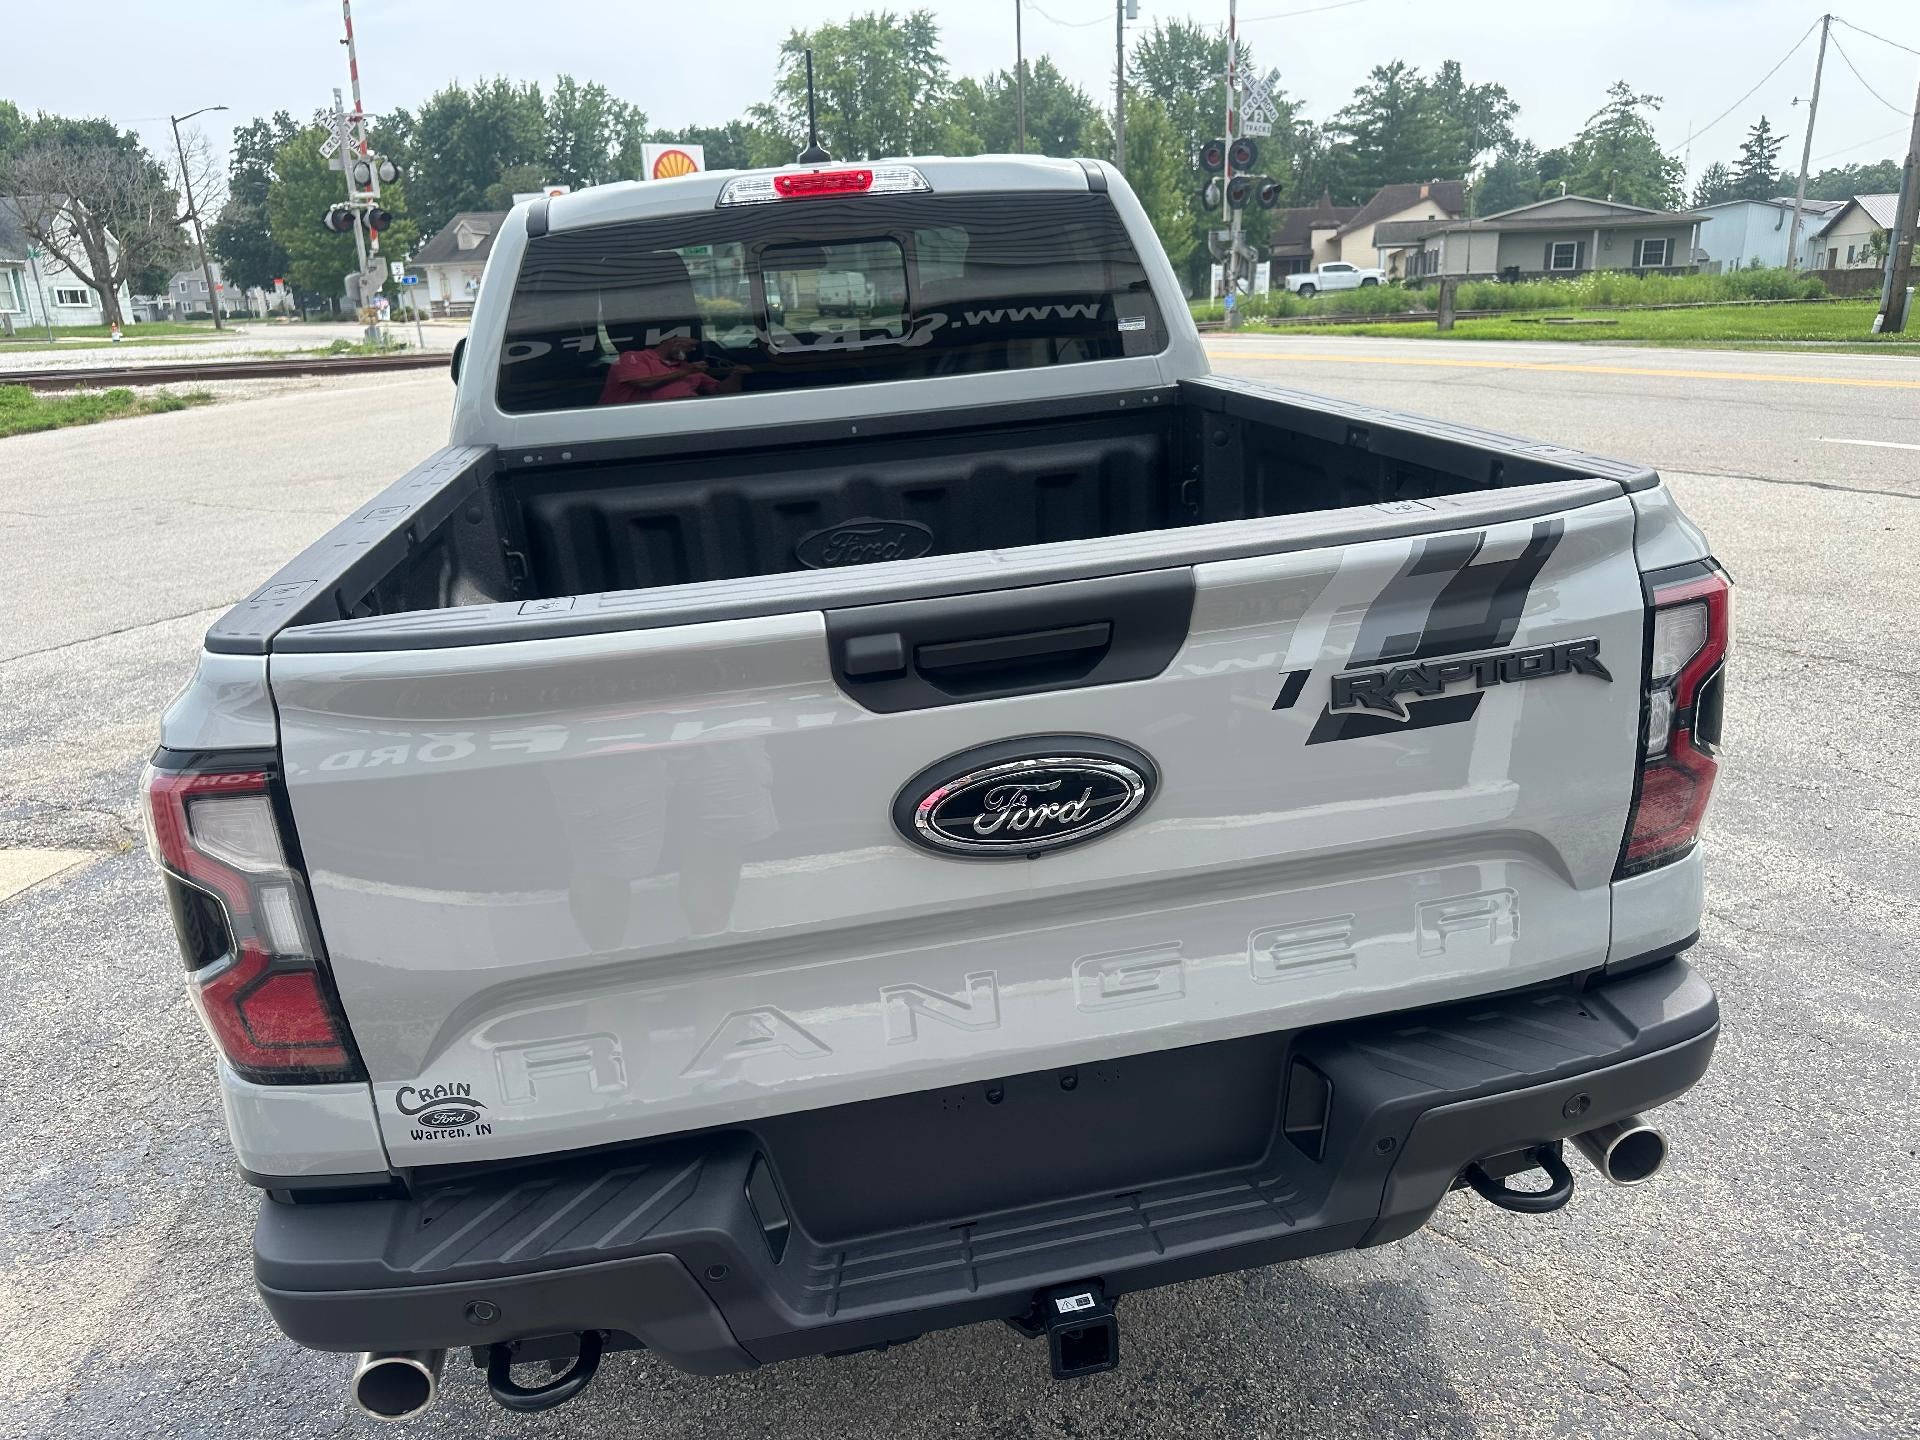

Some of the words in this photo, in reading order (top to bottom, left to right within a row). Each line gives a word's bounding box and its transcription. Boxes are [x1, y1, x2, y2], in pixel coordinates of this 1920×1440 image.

[1245, 124, 1271, 133] TRACKS
[823, 528, 906, 562] Ford
[1331, 636, 1613, 717] RAPTOR
[973, 779, 1093, 835] Ford
[493, 887, 1521, 1104] RANGER
[396, 1082, 488, 1116] CRAIN
[431, 1111, 466, 1125] Ford
[475, 1123, 492, 1136] IN
